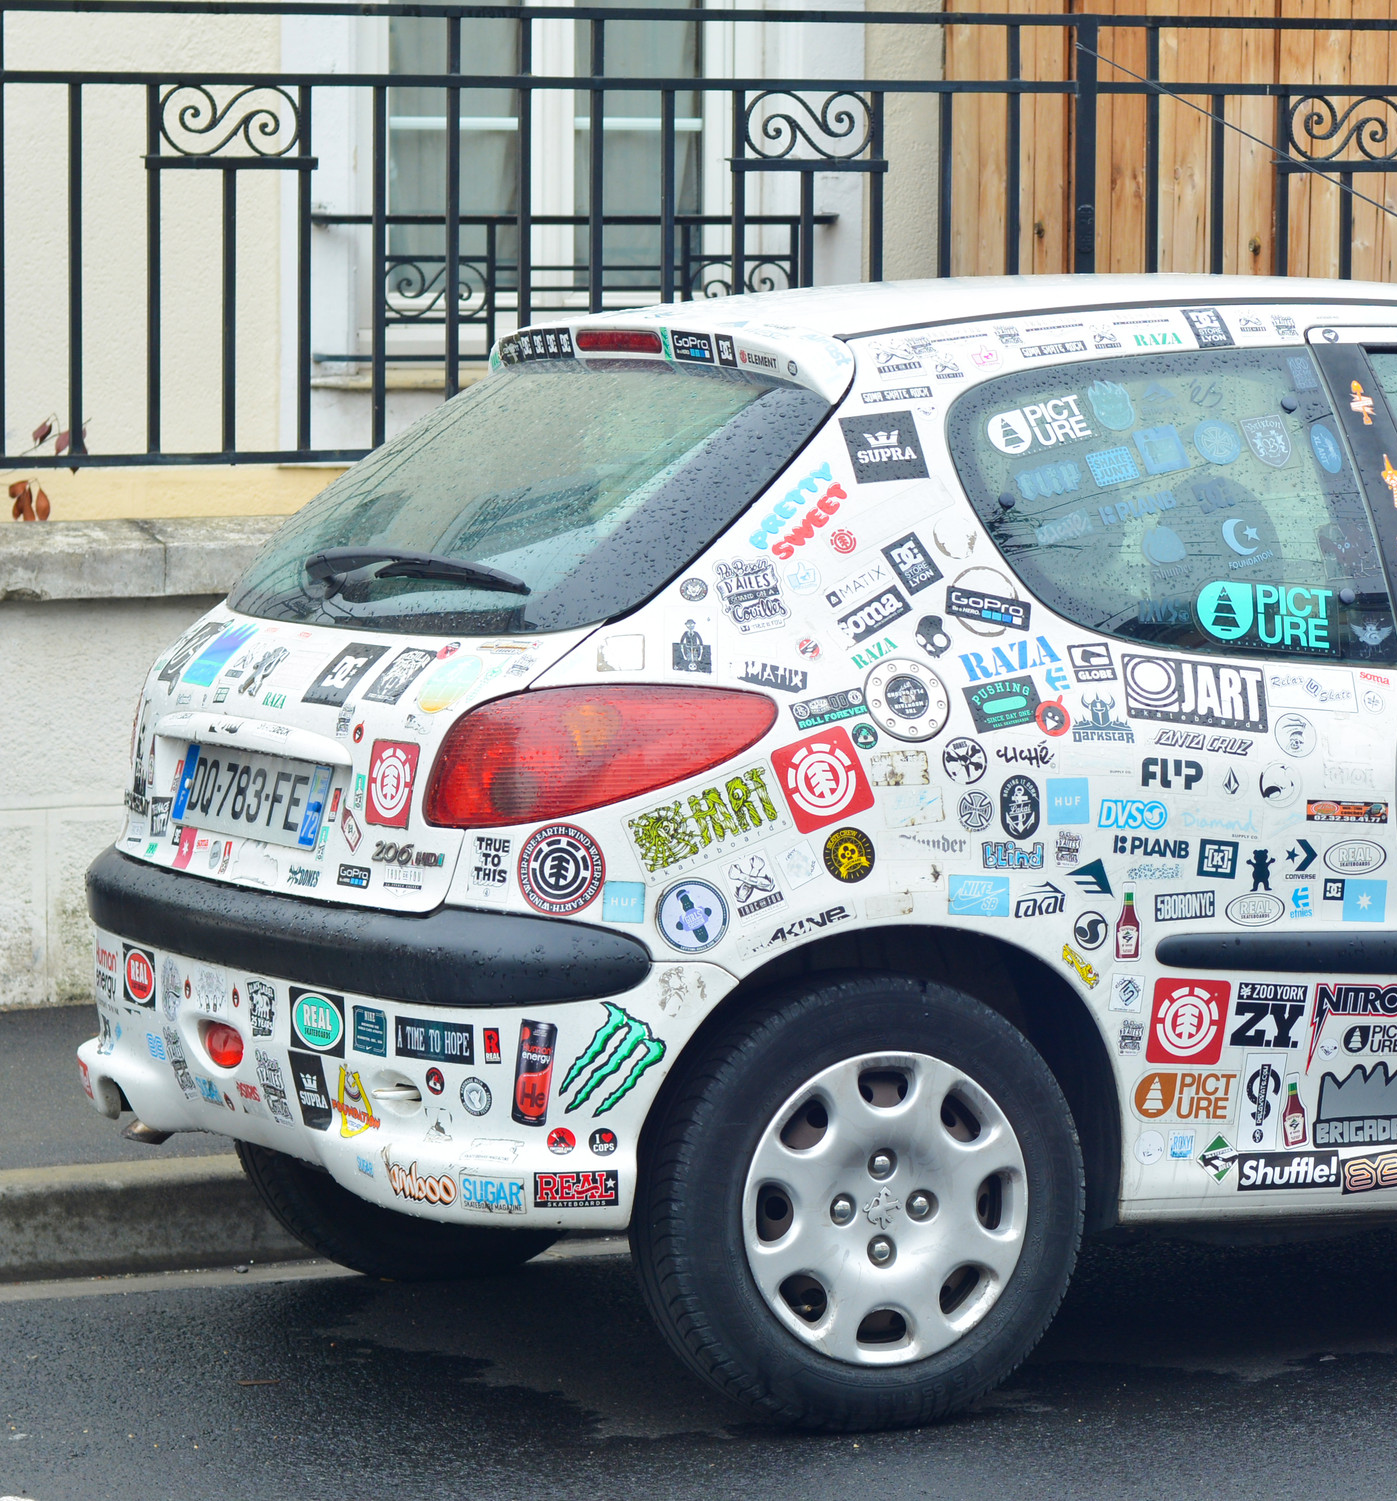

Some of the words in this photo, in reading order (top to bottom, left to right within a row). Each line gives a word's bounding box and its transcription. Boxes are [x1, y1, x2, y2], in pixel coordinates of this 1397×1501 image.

[673, 334, 708, 350] GoPro
[1133, 332, 1183, 347] RAZA
[1201, 334, 1227, 343] LYON
[747, 353, 777, 369] ELEMENT
[1246, 414, 1281, 433] Brixton
[857, 444, 918, 464] SUPRA
[1093, 453, 1127, 469] SHAKE
[1099, 465, 1130, 480] JUNT
[750, 461, 832, 550] PRETTY
[771, 482, 847, 560] SWEET
[905, 562, 929, 579] STORE
[1228, 550, 1274, 570] FOUNDATION
[724, 573, 770, 593] D'AILES
[839, 565, 886, 598] MATIX
[908, 570, 934, 587] LYON
[951, 591, 1024, 618] GoPro
[1256, 584, 1332, 618] PICT
[1257, 613, 1330, 648] URE
[851, 637, 898, 670] RAZA
[1221, 639, 1270, 648] ORGANIC
[1281, 644, 1336, 654] CLOTHING
[958, 635, 1061, 682] RAZA
[1079, 669, 1114, 681] GLOBE
[972, 682, 1030, 705] PUSHING
[1181, 663, 1262, 722] JART
[798, 714, 824, 729] ROLL
[825, 706, 868, 723] FOREVER
[1154, 728, 1206, 750] SANTA
[1206, 735, 1254, 756] CRUZ
[1054, 796, 1081, 807] HUF
[300, 811, 321, 839] 72
[1099, 799, 1144, 828] DVS
[371, 840, 414, 865] 206
[476, 836, 510, 853] TRUE
[482, 853, 501, 866] TO
[340, 867, 369, 880] GoPro
[474, 866, 507, 883] THIS
[962, 880, 993, 897] NIKE
[611, 897, 638, 907] HUF
[981, 897, 999, 910] SB
[1156, 892, 1214, 921] 5BORONYC
[130, 959, 149, 984] REAL
[1252, 984, 1276, 999] ZOO
[1276, 985, 1306, 1000] YORK
[303, 1003, 332, 1031] REAL
[1230, 1002, 1305, 1048] Z.Y.
[397, 1024, 402, 1048] A
[406, 1025, 425, 1051] TIME
[429, 1033, 440, 1053] TO
[443, 1033, 470, 1057] HOPE
[1178, 1073, 1237, 1096] PICT
[300, 1091, 328, 1109] SUPRA
[1176, 1096, 1229, 1119] URE
[332, 1099, 380, 1130] FOUNDATION
[593, 1143, 614, 1152] COPS
[1240, 1156, 1337, 1186] Shuffle!
[462, 1178, 521, 1205] SUGAR
[537, 1173, 615, 1200] REAL
